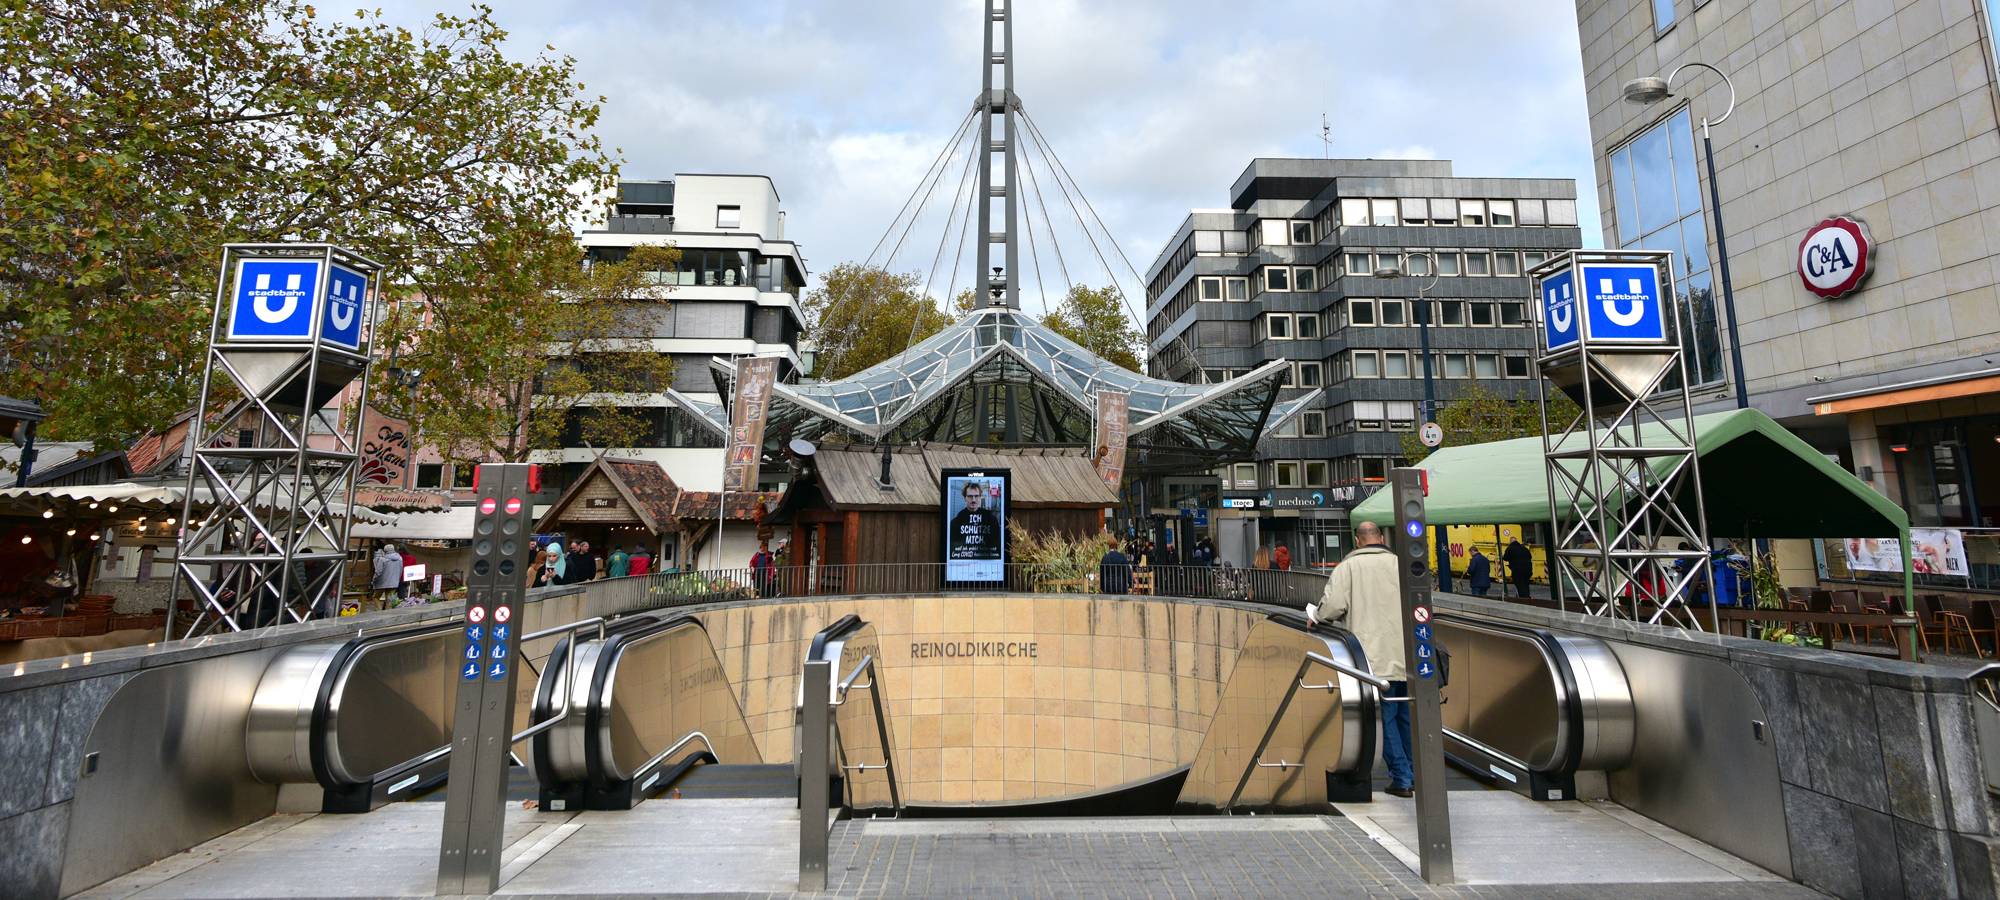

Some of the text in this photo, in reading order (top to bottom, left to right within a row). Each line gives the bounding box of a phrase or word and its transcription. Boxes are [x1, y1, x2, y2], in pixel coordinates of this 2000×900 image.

[1807, 237, 1853, 278] C&A
[248, 289, 305, 297] stadtbahn
[253, 274, 301, 323] U
[329, 294, 359, 309] stadtbahn
[1548, 298, 1574, 311] stadtbahn
[1600, 279, 1644, 326] U
[1425, 430, 1430, 438] 4
[1278, 497, 1317, 506] medneo
[969, 514, 982, 523] ICH
[960, 523, 991, 534] SCHÜTZE
[1946, 557, 1960, 571] ALEX
[910, 642, 1038, 659] REINOLDIKIRCHE
